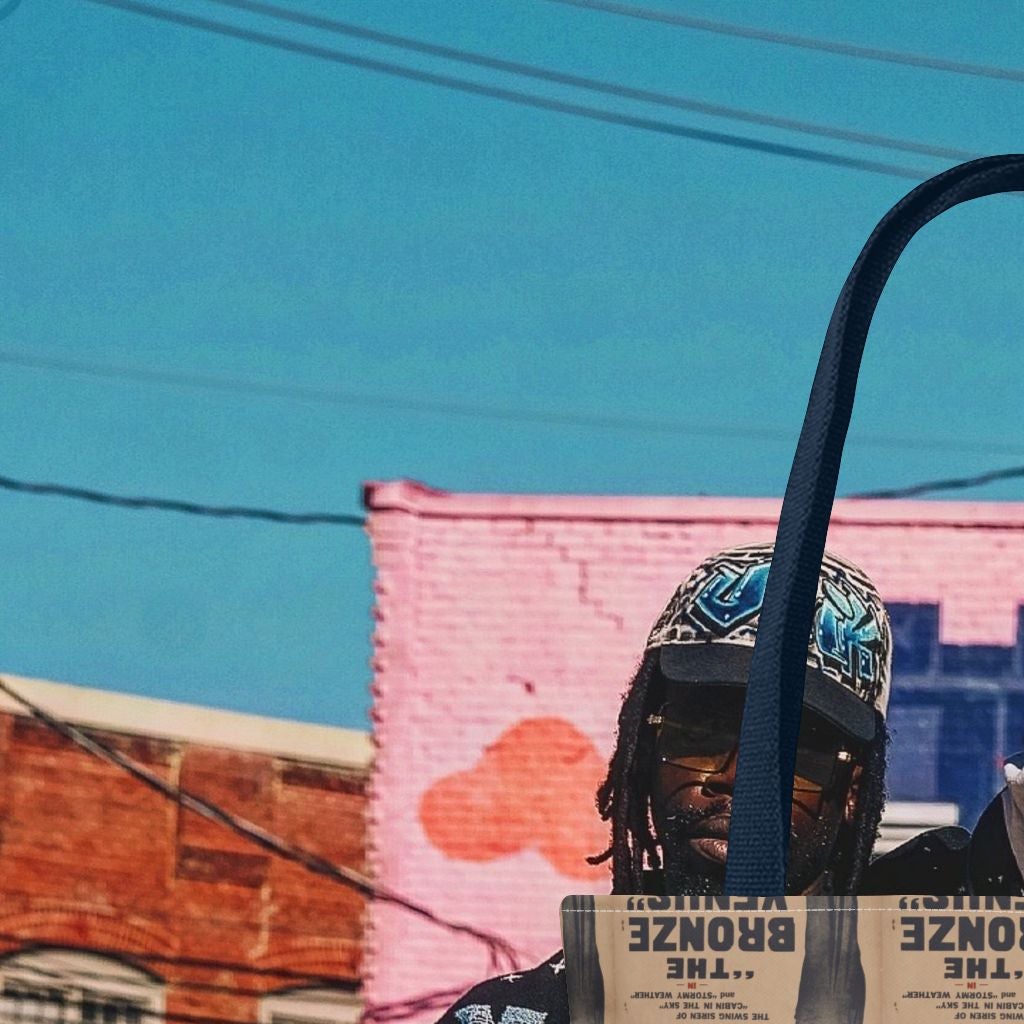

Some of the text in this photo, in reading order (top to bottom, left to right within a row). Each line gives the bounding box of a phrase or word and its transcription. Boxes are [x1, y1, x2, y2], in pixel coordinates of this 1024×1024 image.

[629, 916, 795, 952] BRONZE
[666, 958, 754, 979] “THE
[677, 991, 717, 999] “STORMY
[956, 991, 997, 999] “STORMY
